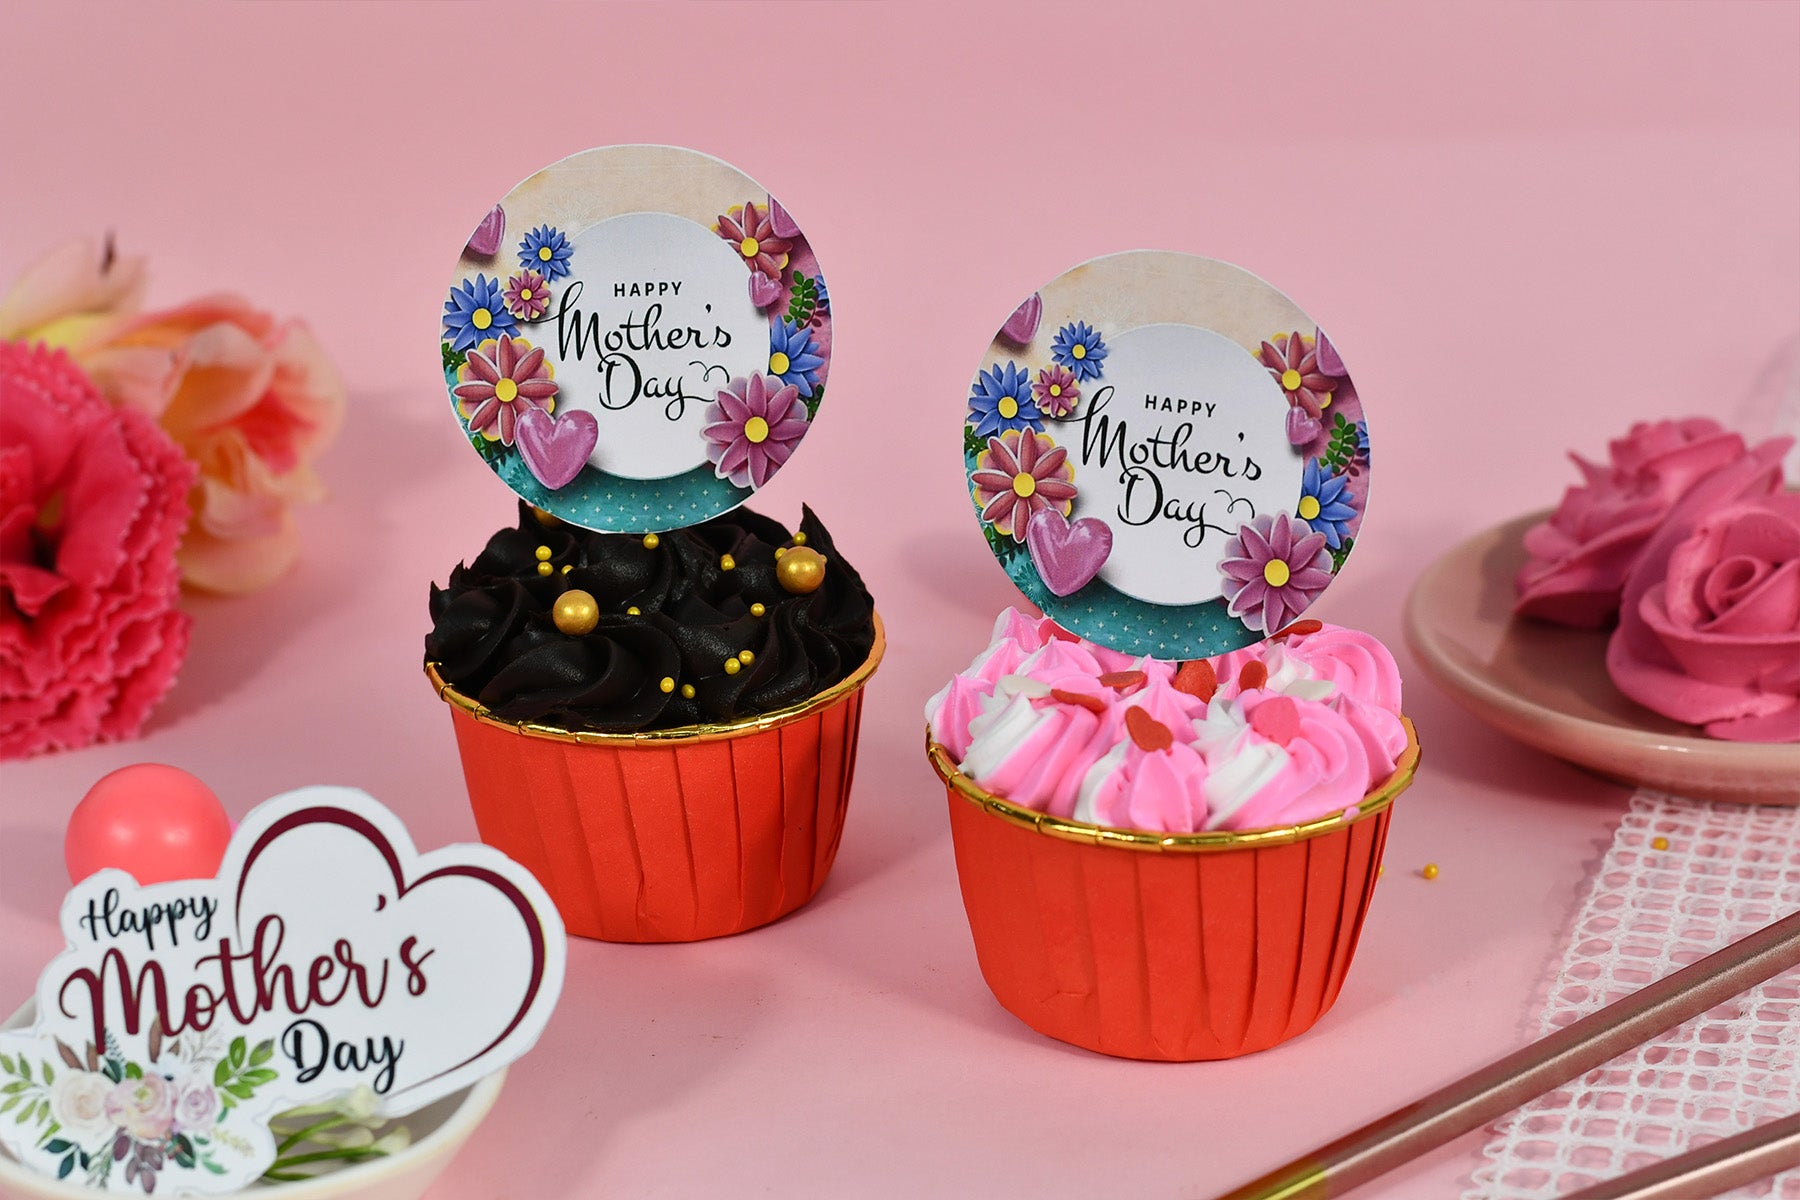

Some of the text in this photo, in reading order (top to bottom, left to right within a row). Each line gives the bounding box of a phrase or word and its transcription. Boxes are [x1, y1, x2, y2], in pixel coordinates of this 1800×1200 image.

[533, 280, 732, 366] Mother's
[614, 281, 682, 297] HAPPY
[597, 352, 730, 421] Day
[1144, 394, 1216, 418] HAPPY
[1057, 385, 1262, 481] Mother's
[1117, 466, 1255, 548] Day
[79, 887, 218, 950] Happy
[58, 894, 435, 1055] Mother's
[281, 1018, 405, 1094] Day
